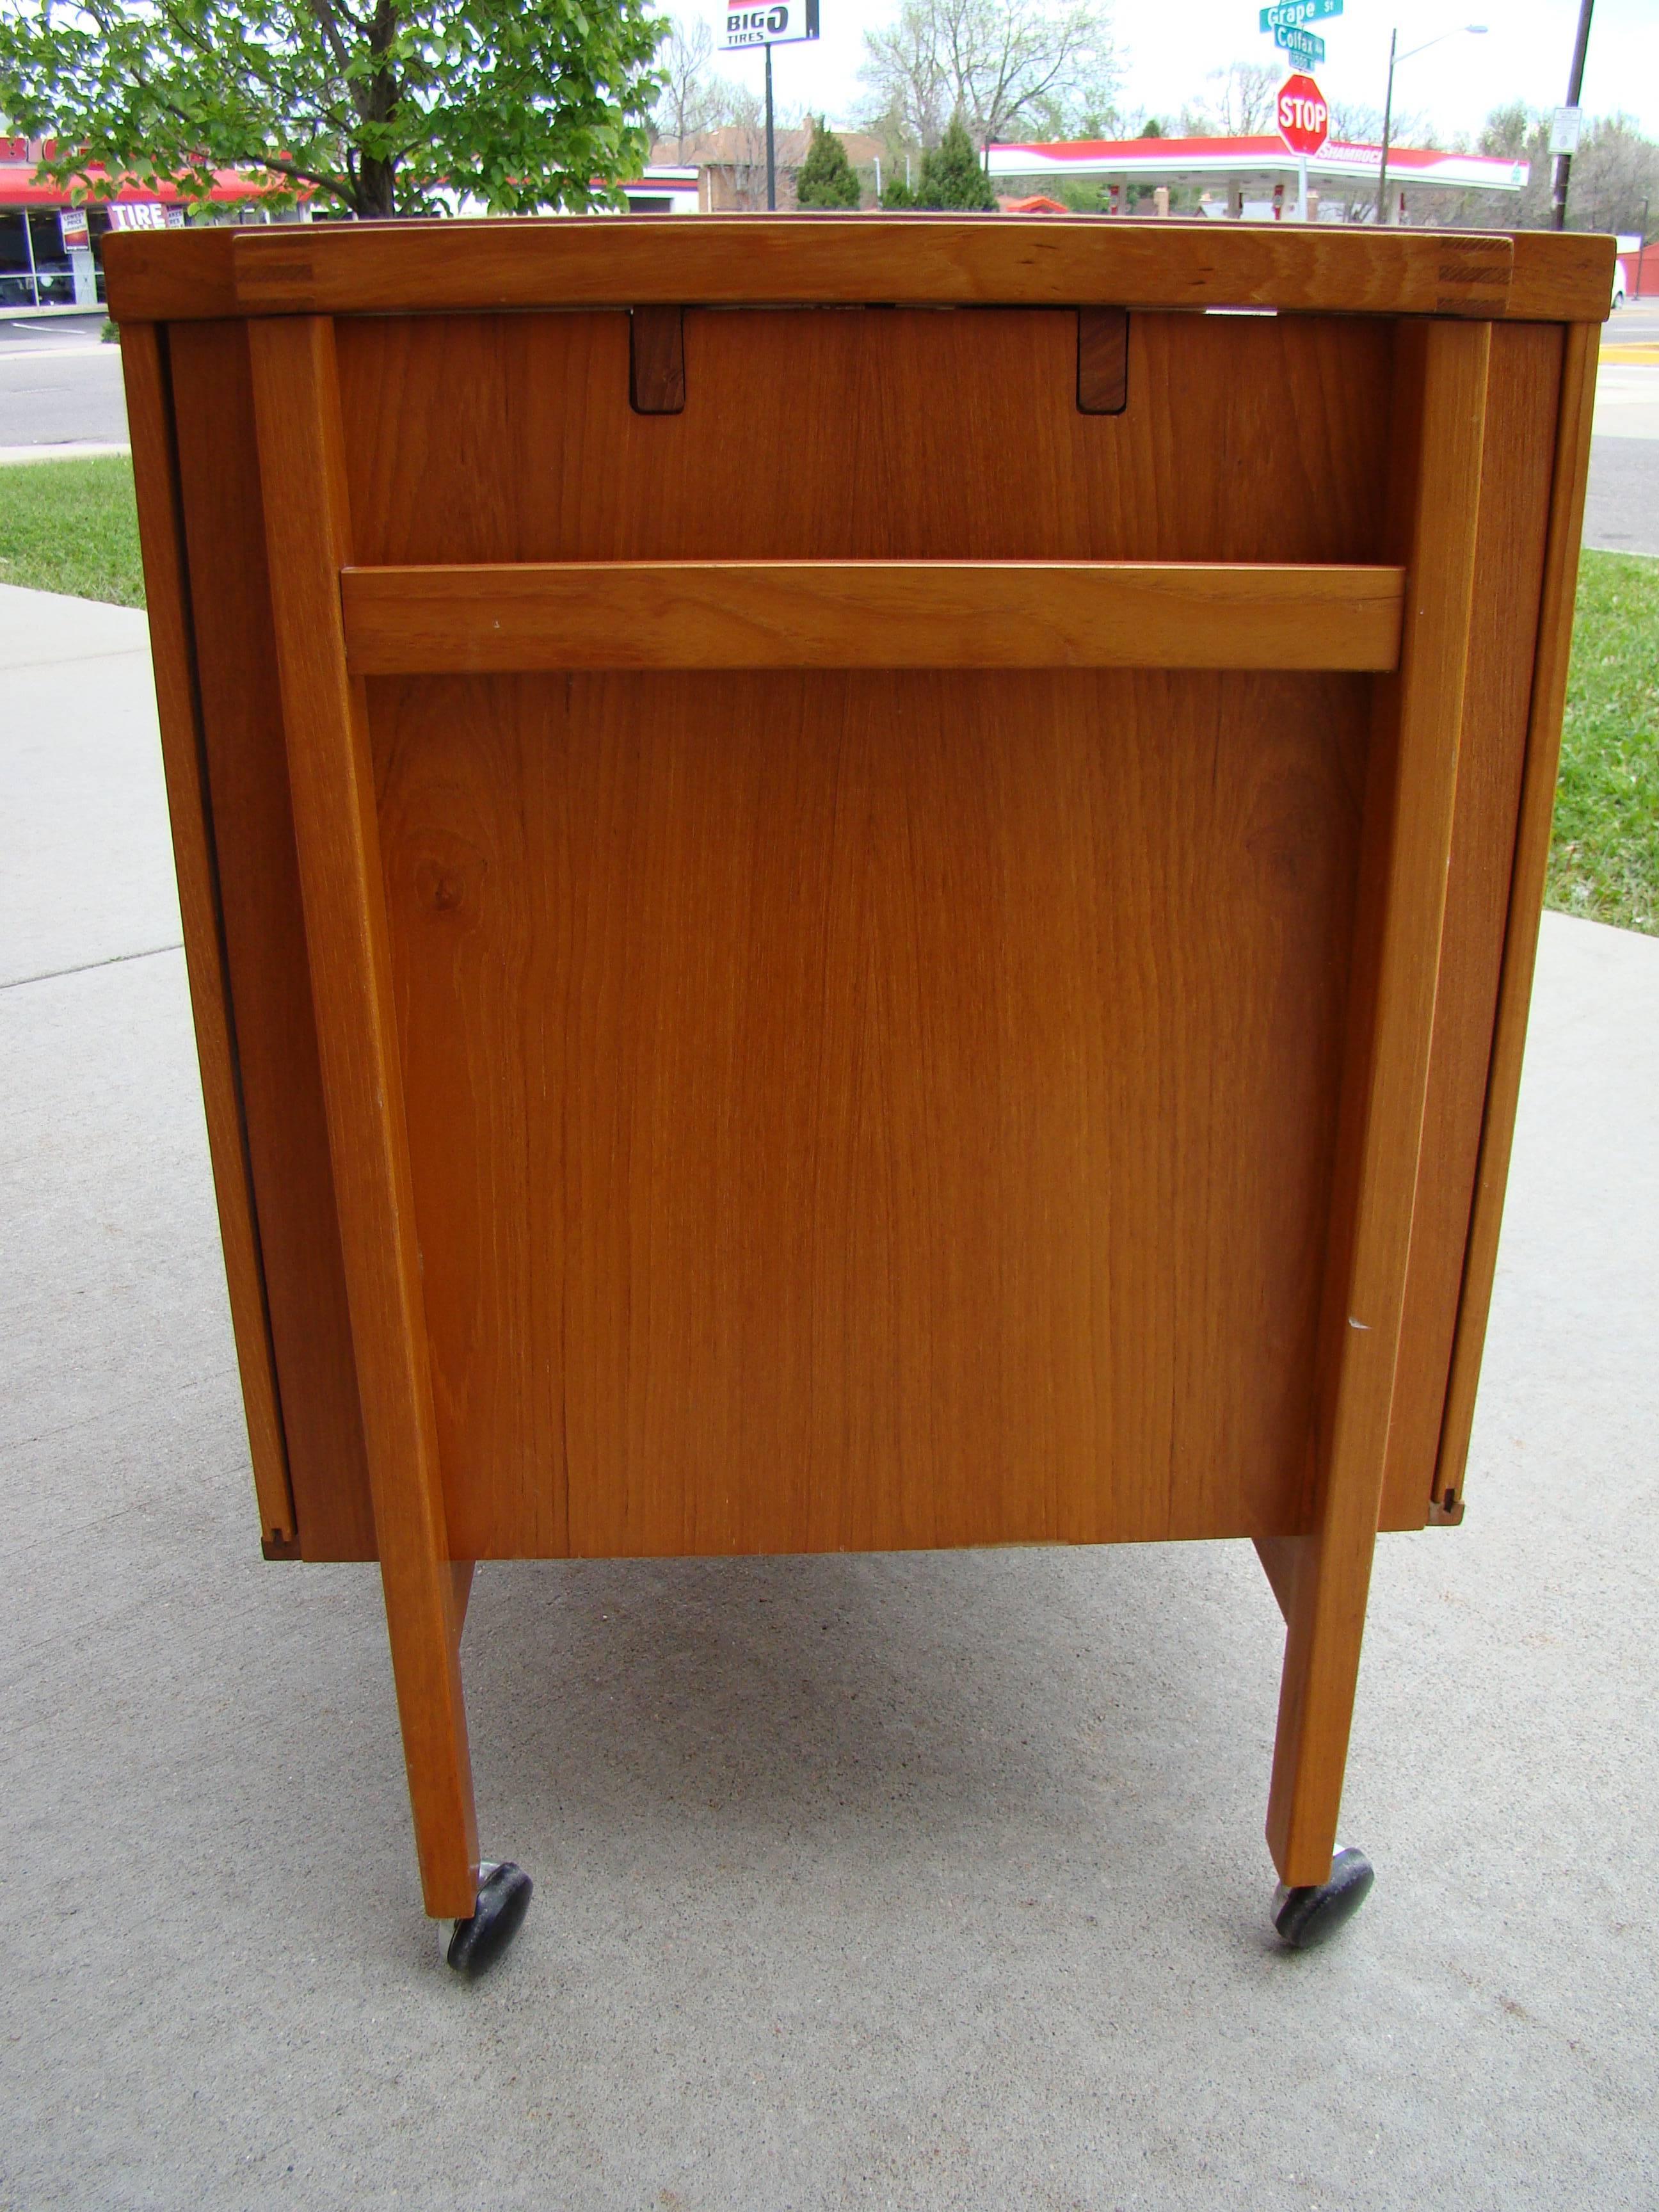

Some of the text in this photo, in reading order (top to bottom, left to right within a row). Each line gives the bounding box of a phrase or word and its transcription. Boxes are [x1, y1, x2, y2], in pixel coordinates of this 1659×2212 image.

[727, 6, 789, 33] BIG O
[1268, 3, 1315, 27] Grape
[728, 32, 764, 44] TIRES
[1278, 26, 1313, 54] Colfax
[1280, 97, 1326, 132] STOP
[111, 204, 165, 225] TIRE
